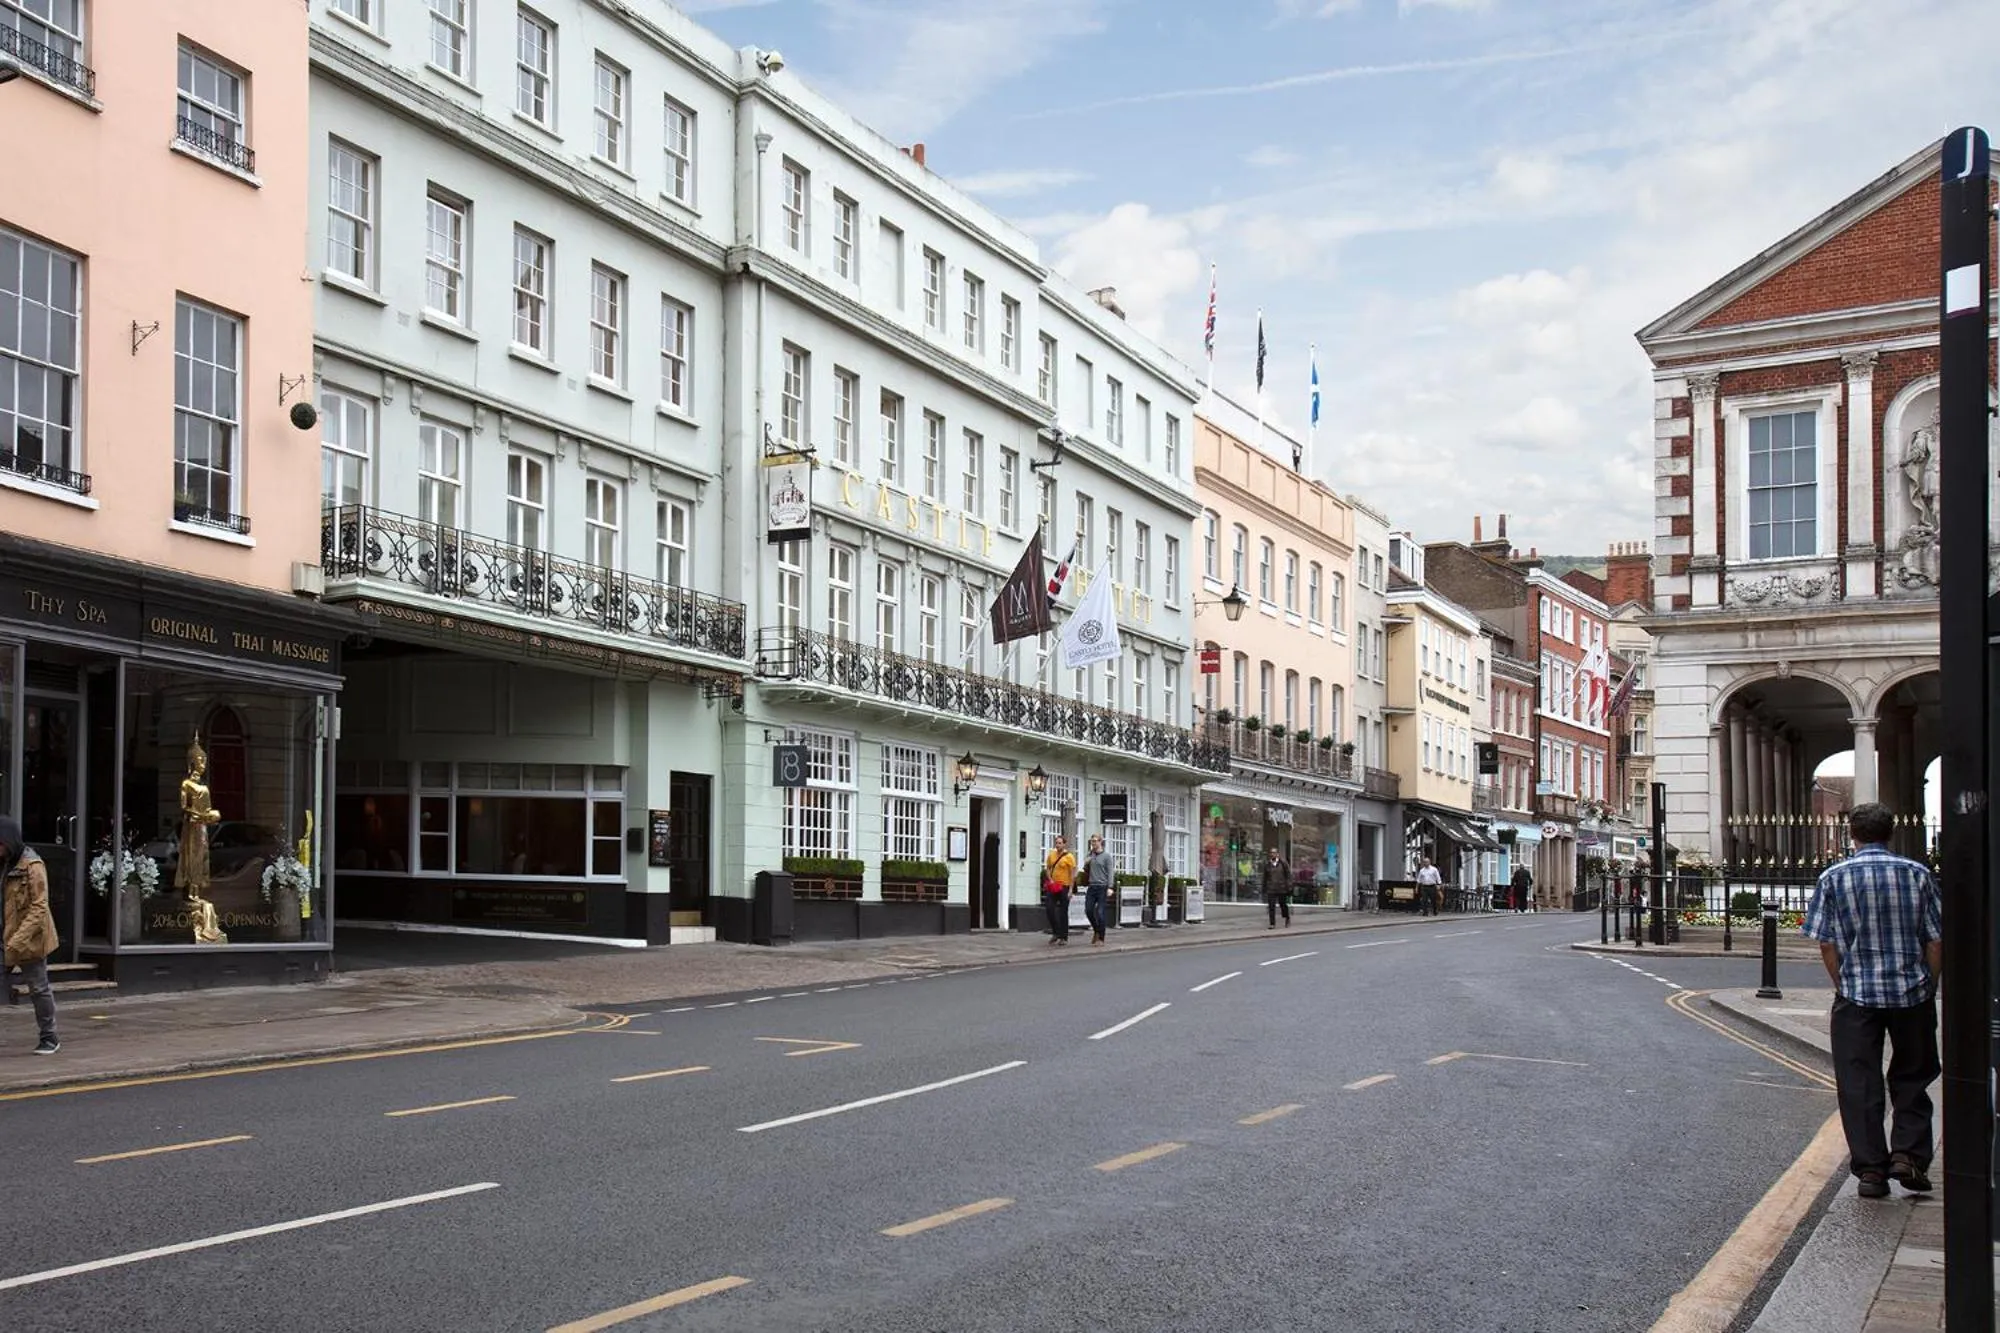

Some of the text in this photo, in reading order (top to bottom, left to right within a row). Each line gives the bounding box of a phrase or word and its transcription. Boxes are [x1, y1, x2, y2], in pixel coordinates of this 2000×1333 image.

[841, 471, 1152, 625] CASTLE HTEL
[23, 589, 108, 624] THY SPA
[151, 617, 330, 664] ORIGINAL THAI MASSAGE
